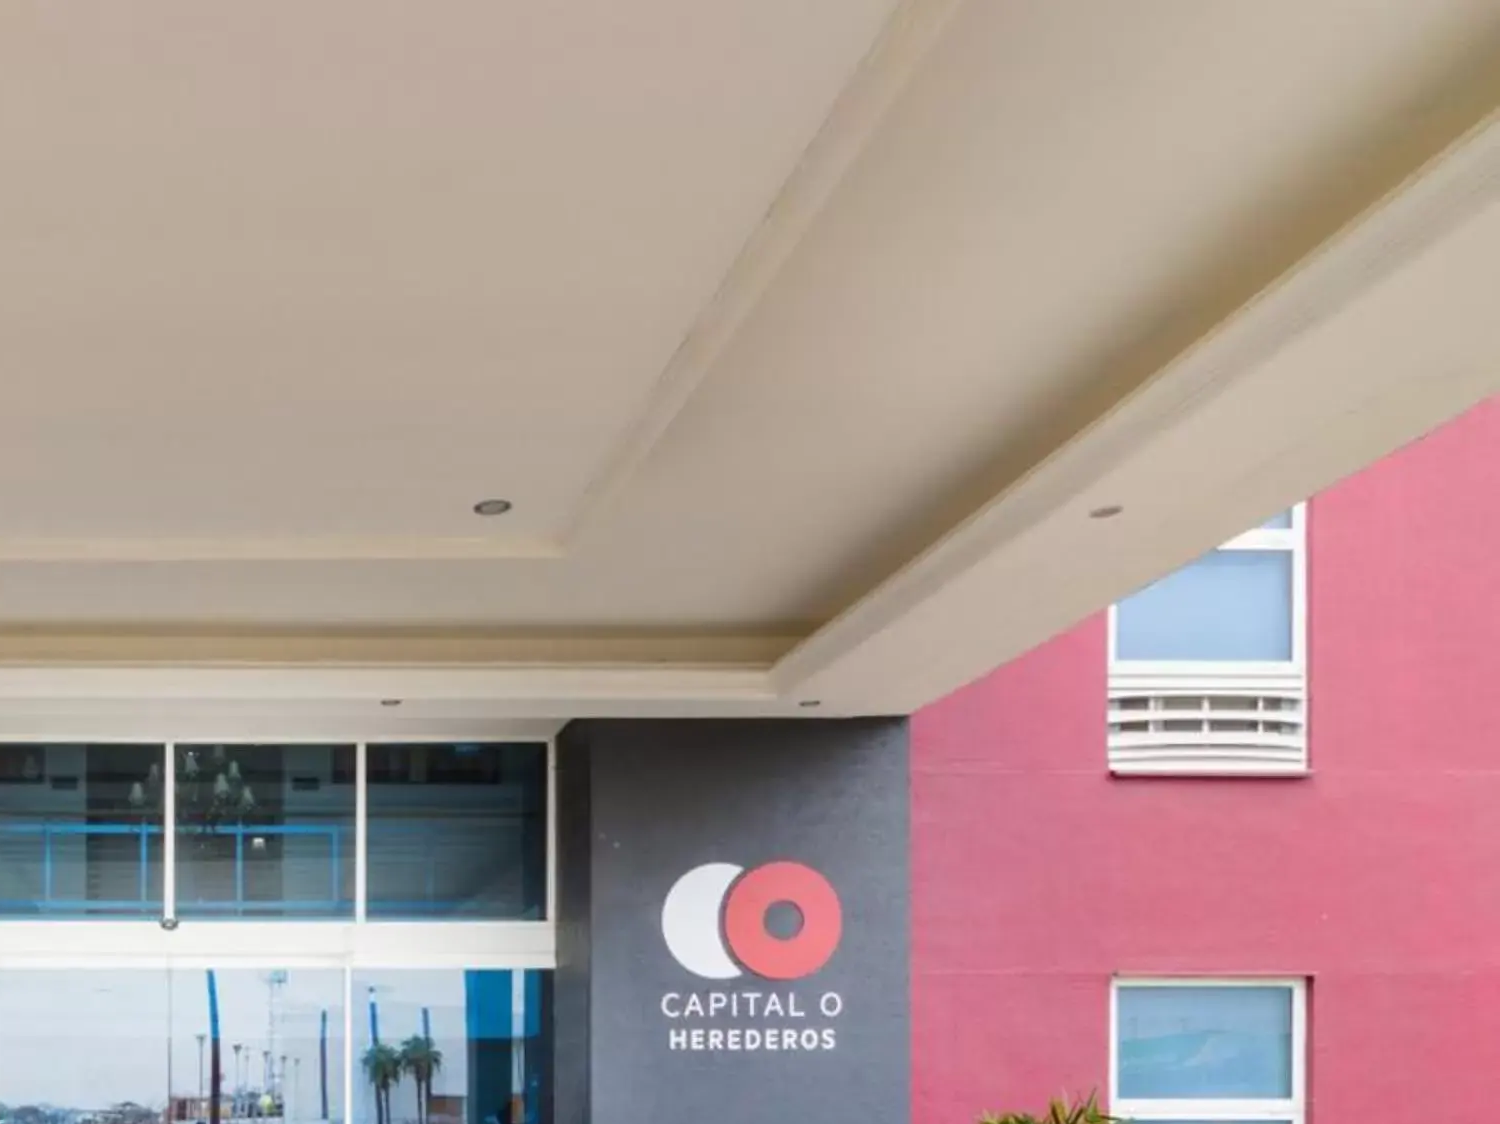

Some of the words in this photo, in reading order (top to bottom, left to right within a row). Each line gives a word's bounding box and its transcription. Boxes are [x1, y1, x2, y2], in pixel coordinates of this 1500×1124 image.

[661, 992, 805, 1017] CAPITAL
[819, 992, 843, 1017] O
[669, 1029, 836, 1050] HEREDEROS
